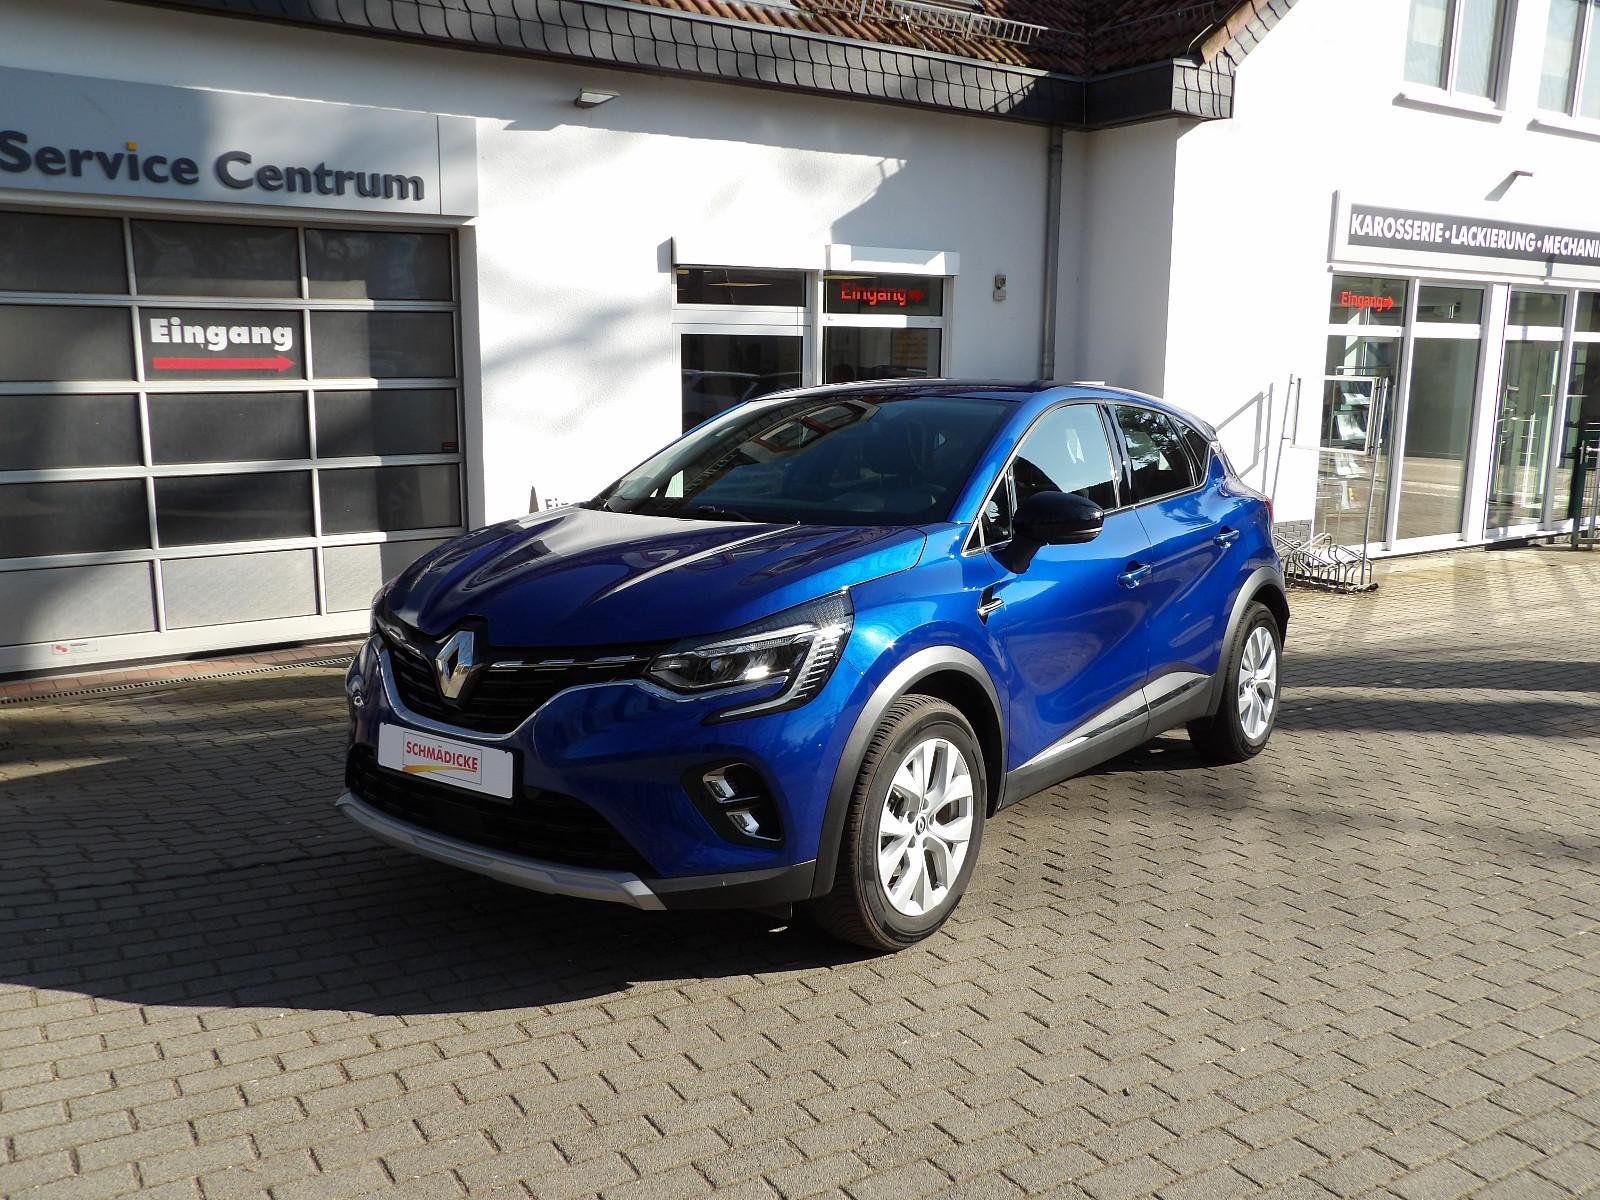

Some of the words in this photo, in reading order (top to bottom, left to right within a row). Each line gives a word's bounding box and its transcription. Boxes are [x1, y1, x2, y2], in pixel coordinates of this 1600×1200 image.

[0, 130, 199, 185] Service
[216, 150, 425, 202] Centrum
[1350, 212, 1444, 243] KAROSSERIE
[1450, 224, 1536, 253] LACKIERUNG
[1541, 234, 1600, 259] MECHANI
[840, 281, 907, 306] Eingang
[1340, 291, 1383, 312] Eingang
[150, 317, 293, 351] Eingang
[406, 740, 478, 771] SCHMÄDICKE
